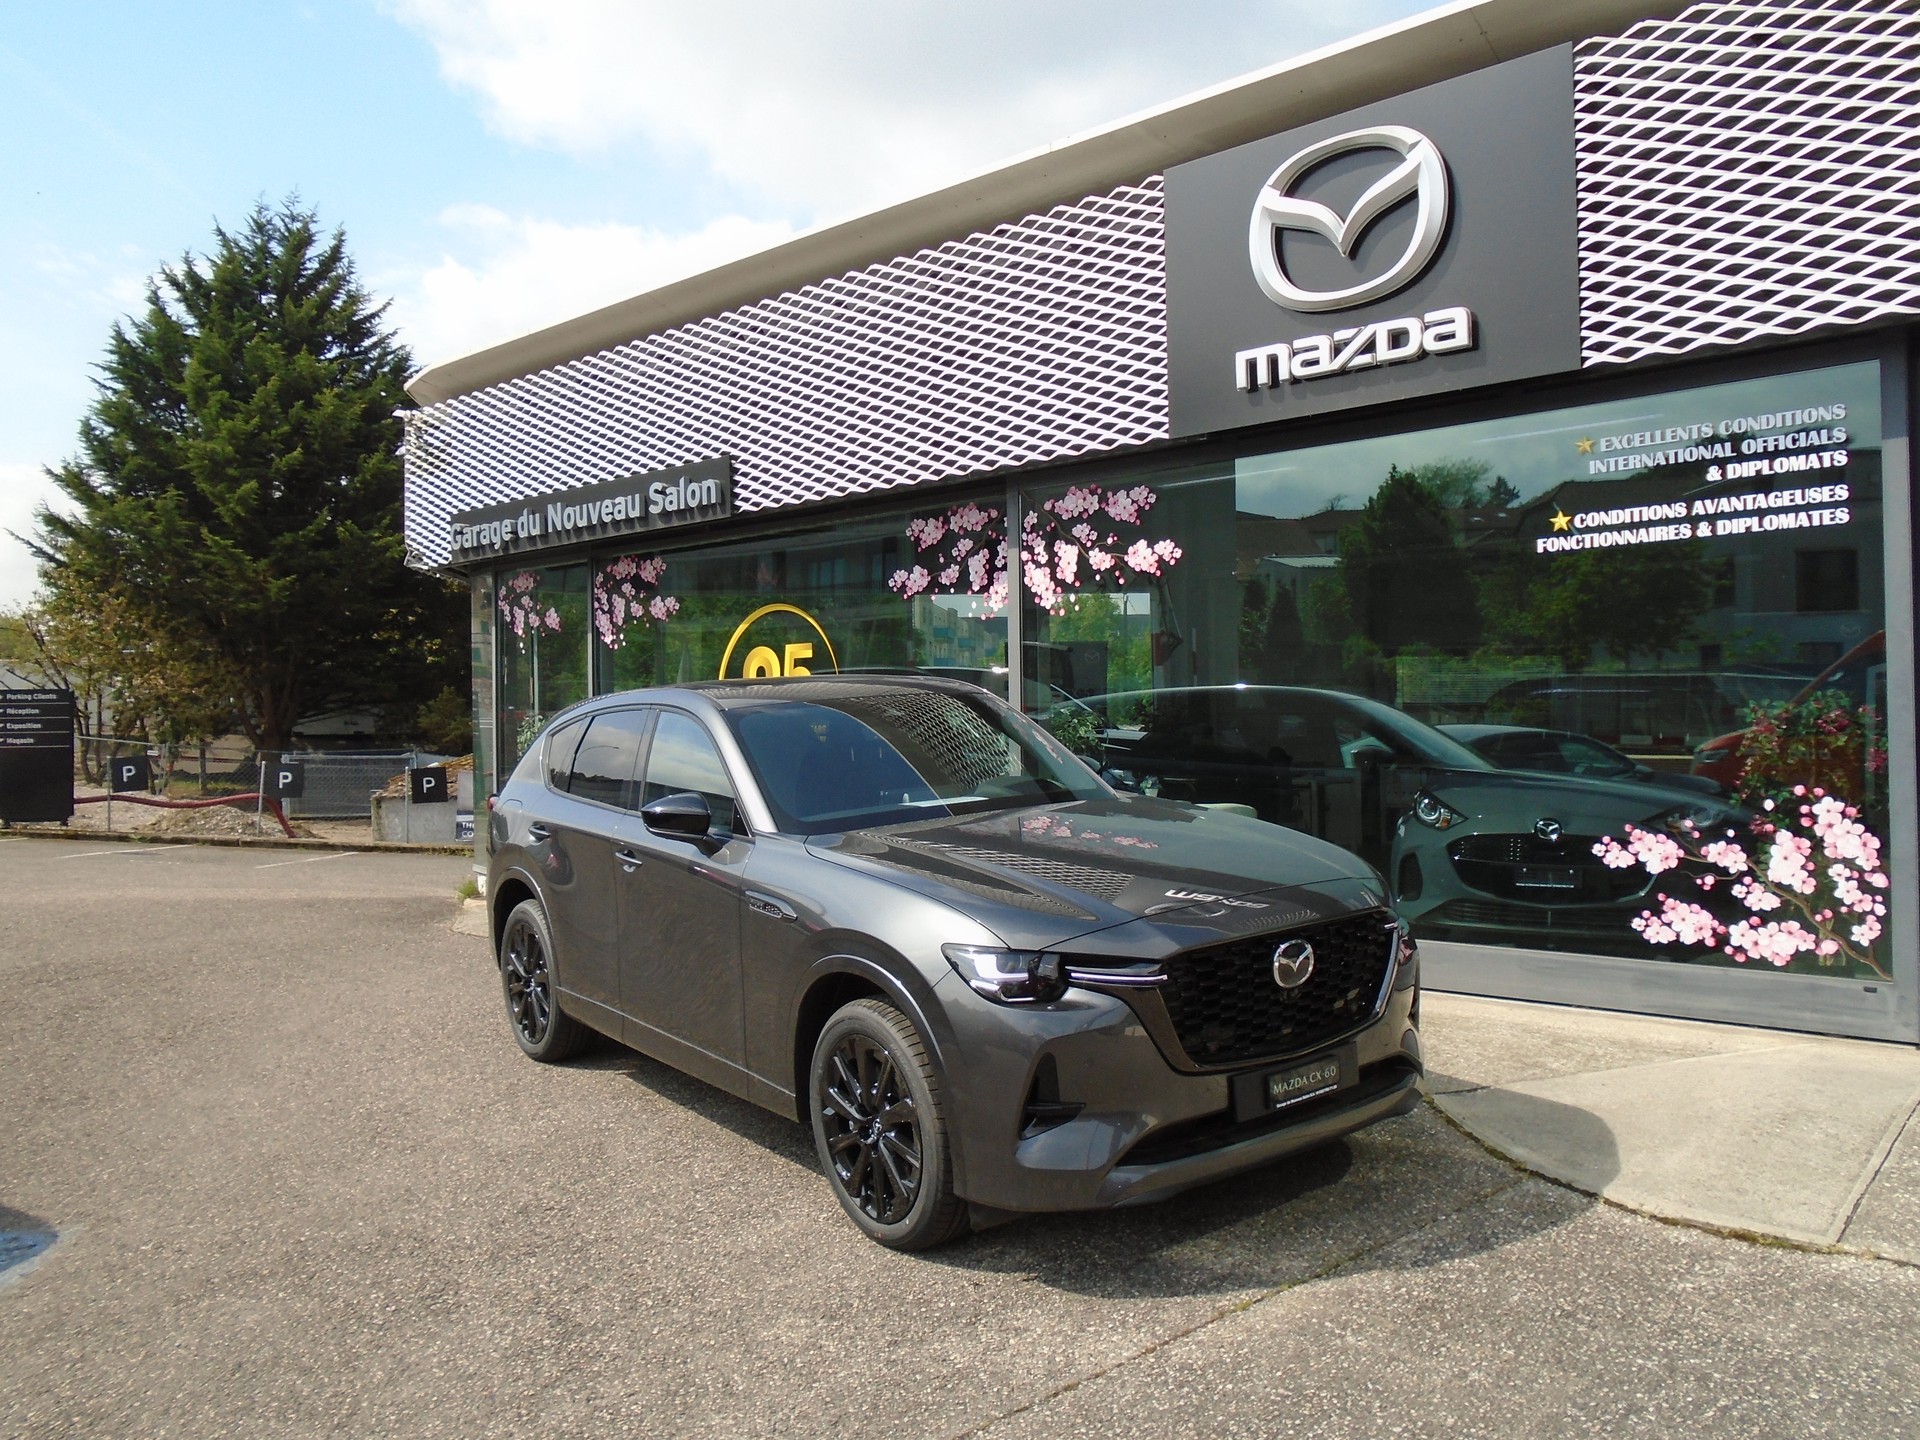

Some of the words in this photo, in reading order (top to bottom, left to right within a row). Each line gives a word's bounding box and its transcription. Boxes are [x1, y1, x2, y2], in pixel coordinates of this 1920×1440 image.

[1600, 422, 1713, 452] EXCELLENTS
[1719, 403, 1847, 435] CONDITIONS
[1589, 442, 1737, 475] INTERNATIONAL
[1741, 426, 1847, 456] OFFICIALS
[1705, 464, 1723, 482] &
[1727, 450, 1848, 480] DIPLOMATS
[450, 518, 513, 550] Garage
[517, 508, 541, 538] du
[547, 493, 641, 532] Nouveau
[649, 476, 719, 514] Salon
[1573, 502, 1688, 529] CONDITIONS
[1691, 484, 1849, 516] AVANTAGEUSES
[1536, 523, 1692, 553] FONCTIONNAIRES
[1696, 521, 1713, 538] &
[1716, 508, 1850, 537] DIPLOMATES
[122, 765, 136, 782] P
[278, 771, 293, 789] P
[422, 776, 436, 794] P
[1272, 1075, 1308, 1095] MAZDA
